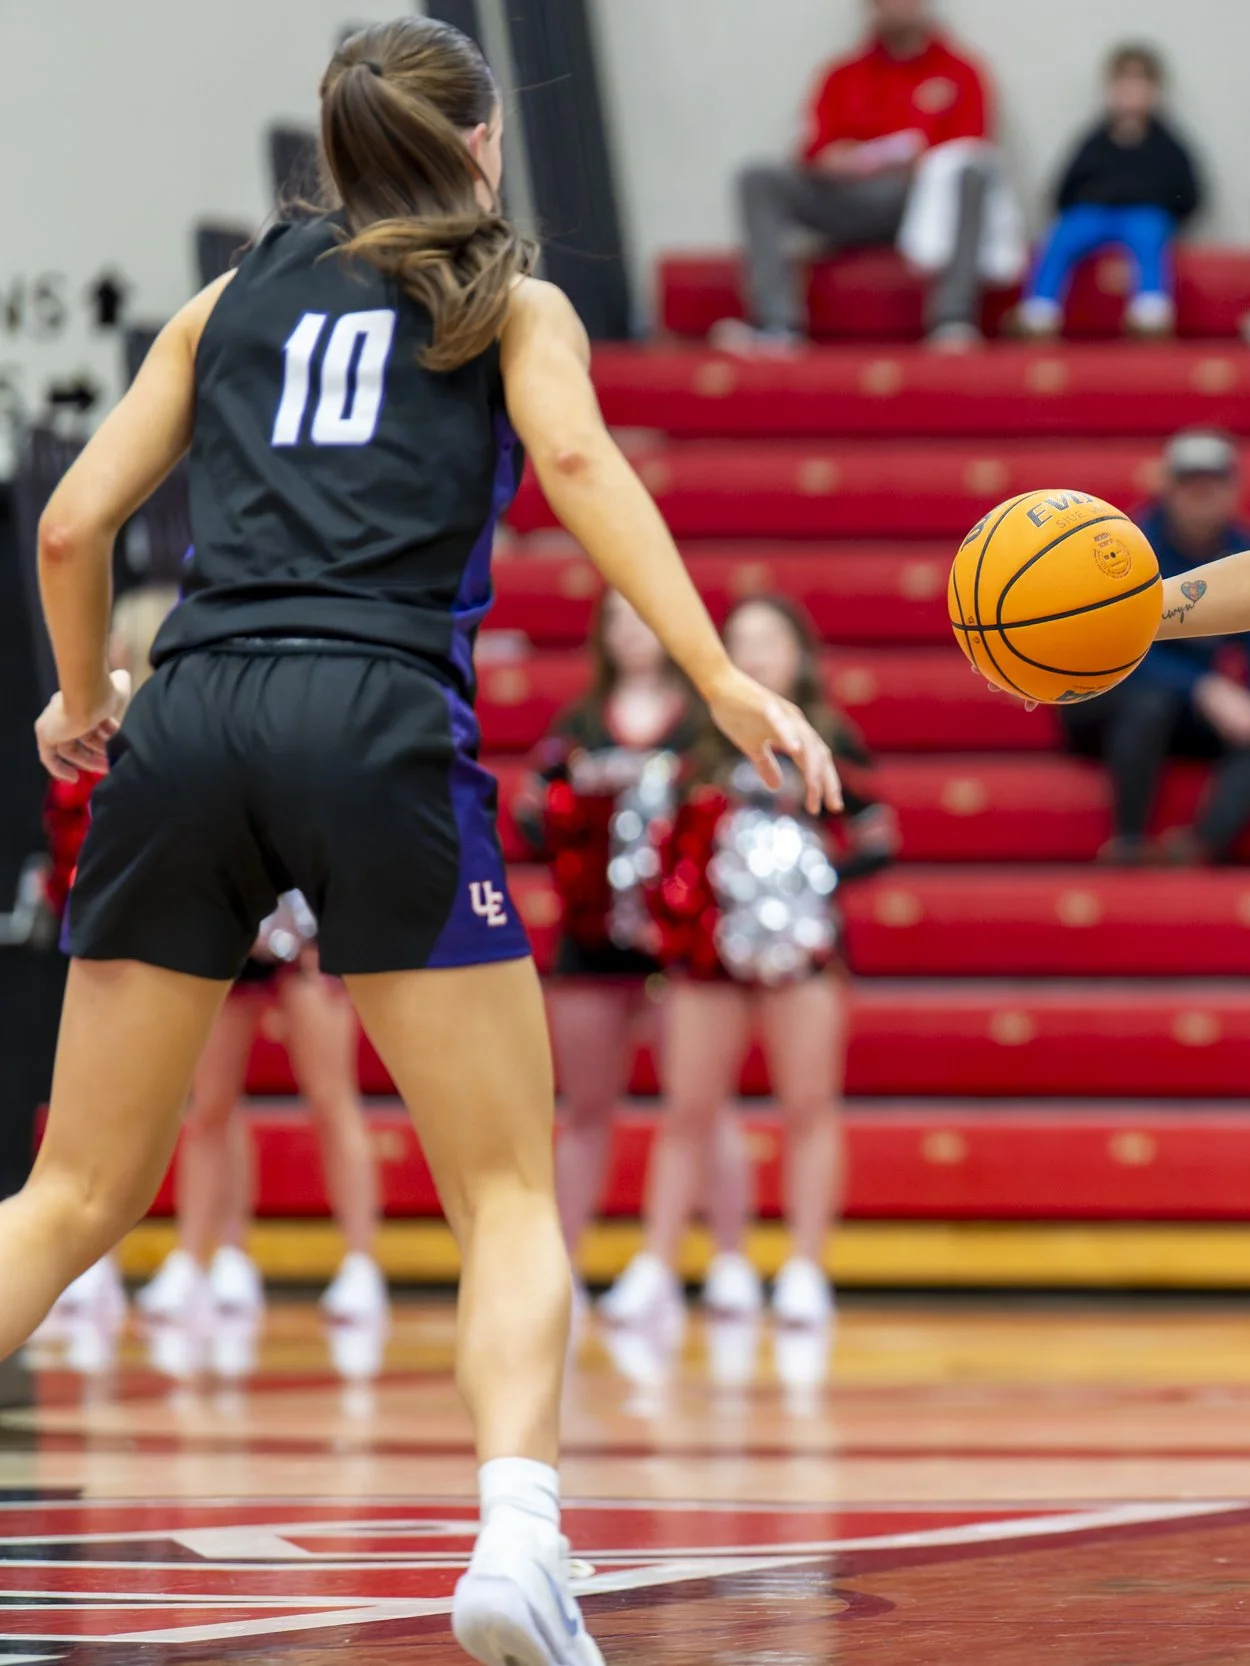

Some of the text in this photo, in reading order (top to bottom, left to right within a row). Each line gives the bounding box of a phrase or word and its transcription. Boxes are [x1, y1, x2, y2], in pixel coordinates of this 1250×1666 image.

[271, 309, 396, 446] 10
[1056, 511, 1085, 528] SIUE
[468, 880, 508, 927] UE
